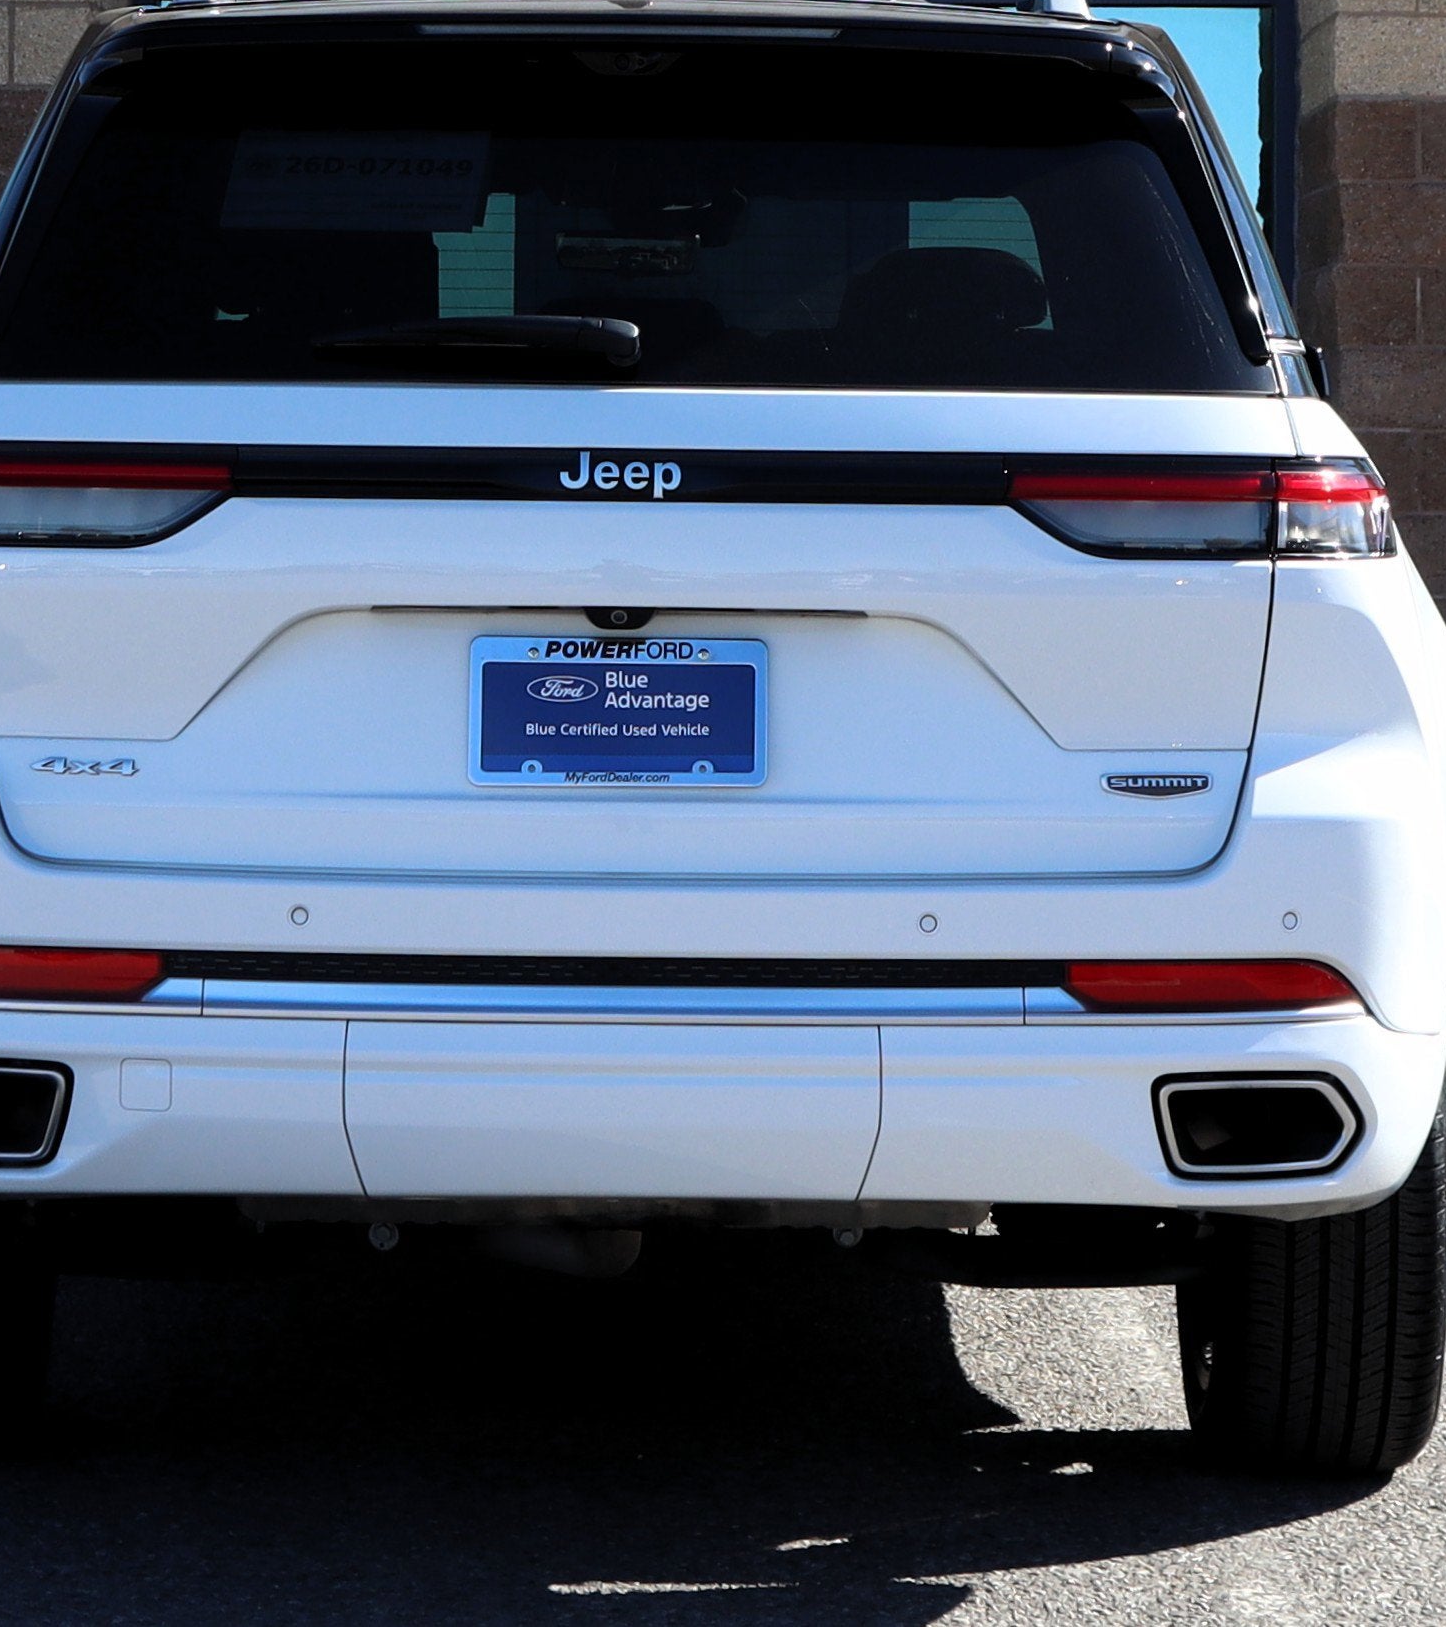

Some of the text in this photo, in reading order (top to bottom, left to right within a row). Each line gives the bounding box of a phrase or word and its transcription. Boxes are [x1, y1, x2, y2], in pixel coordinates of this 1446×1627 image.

[559, 451, 682, 499] Jeep
[544, 640, 694, 660] POWERFORD
[539, 679, 585, 698] Ford
[605, 671, 648, 689] Blue
[604, 690, 710, 712] Advantage
[525, 723, 710, 736] Blue Certified Used Vehicle
[30, 756, 140, 777] 4x4
[564, 772, 671, 784] MyFordDealer.com
[1110, 777, 1207, 788] SUMMIT
